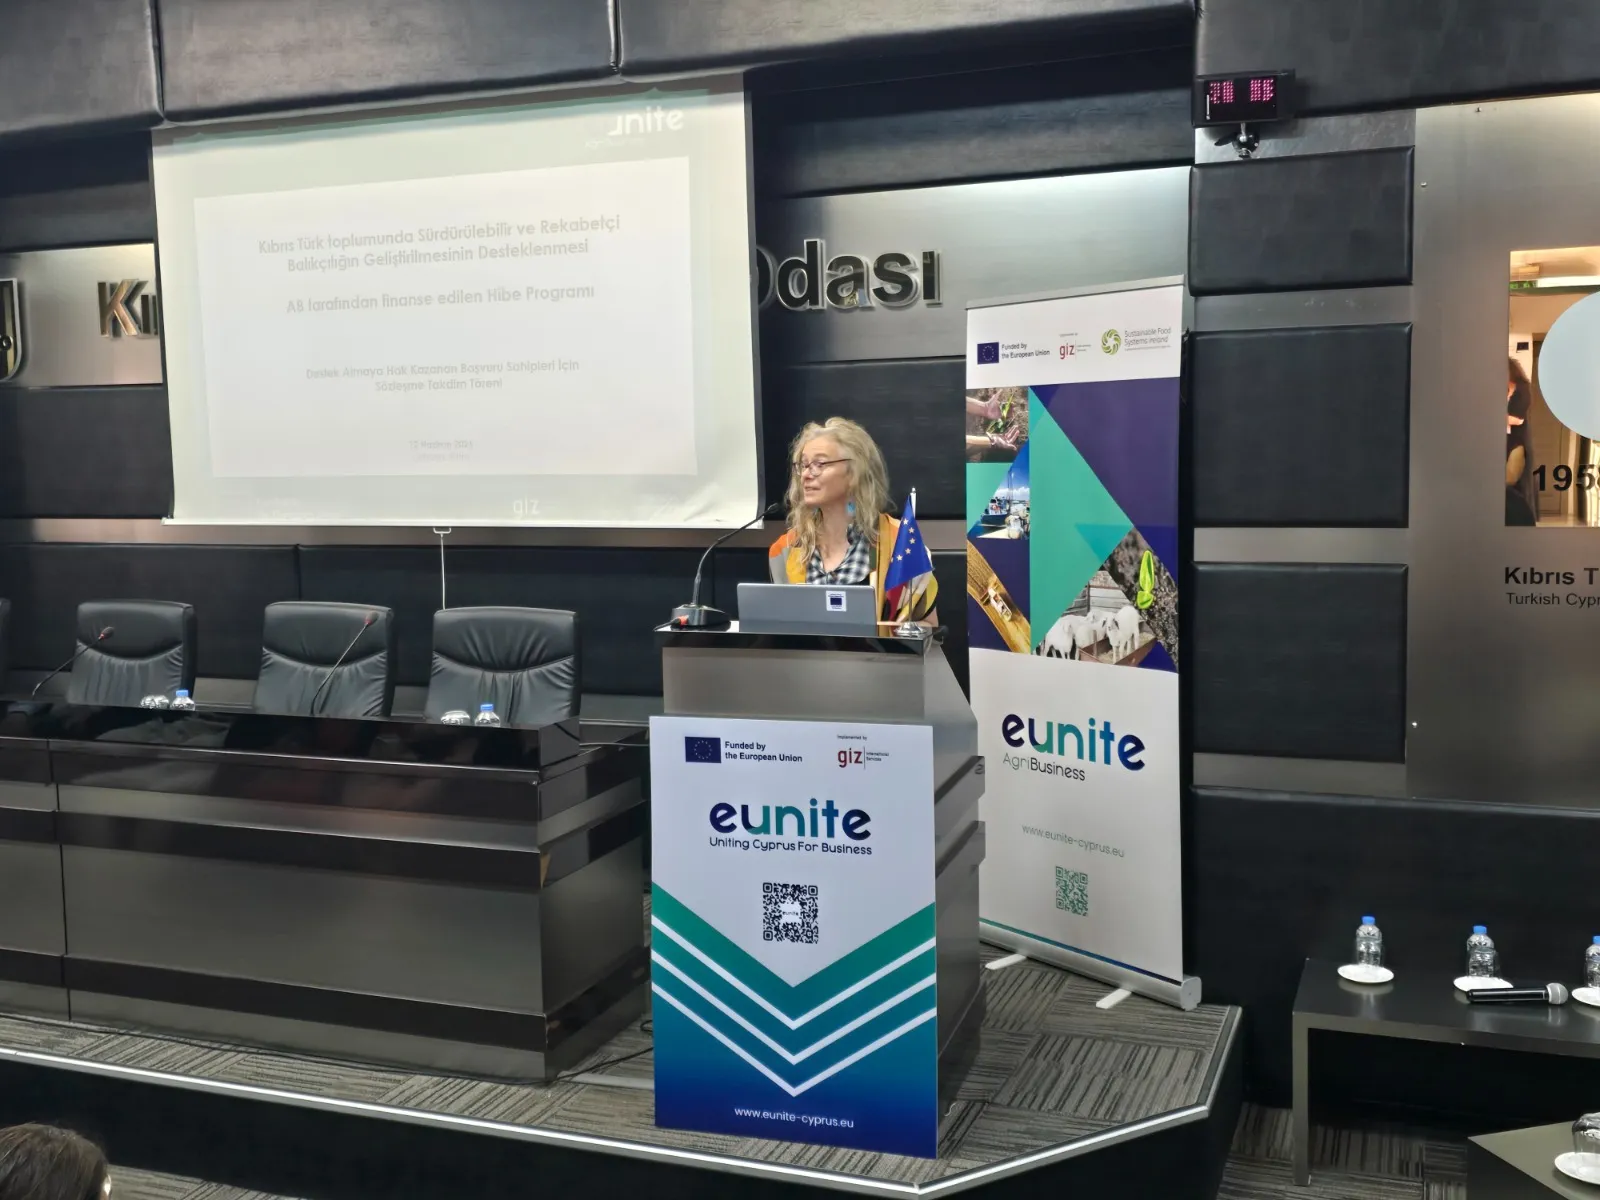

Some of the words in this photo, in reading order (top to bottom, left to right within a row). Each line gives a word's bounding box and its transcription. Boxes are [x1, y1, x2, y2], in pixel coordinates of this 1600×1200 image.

[258, 239, 295, 254] Kıbrıs
[297, 235, 324, 250] Türk
[418, 221, 512, 242] Sürdürülebilir
[517, 223, 535, 235] ve
[540, 214, 620, 234] Rekabetçi
[478, 238, 588, 260] Desteklenmesi
[437, 290, 483, 304] edilen
[487, 286, 521, 302] Hibe
[1001, 343, 1019, 351] Funded
[1020, 342, 1027, 351] by
[1010, 350, 1034, 359] European
[1035, 349, 1051, 358] Union
[1059, 343, 1075, 360] giz
[1532, 464, 1600, 491] 195
[1504, 567, 1575, 585] Kıbrıs
[1507, 592, 1560, 605] Turkish
[724, 740, 755, 750] Funded
[757, 742, 766, 752] by
[1002, 713, 1145, 771] eunite
[725, 751, 738, 760] the
[739, 752, 777, 762] European
[779, 753, 803, 762] Union
[837, 747, 863, 768] giz
[1003, 752, 1085, 781] AgriBusiness
[709, 798, 871, 840] eunite
[709, 836, 750, 851] Uniting
[752, 838, 796, 852] Cyprus
[797, 841, 819, 852] For
[821, 842, 873, 855] Business
[1022, 823, 1125, 858] www.eunite-cyprus.eu
[734, 1107, 855, 1128] www.eunite-cyprus.eu
